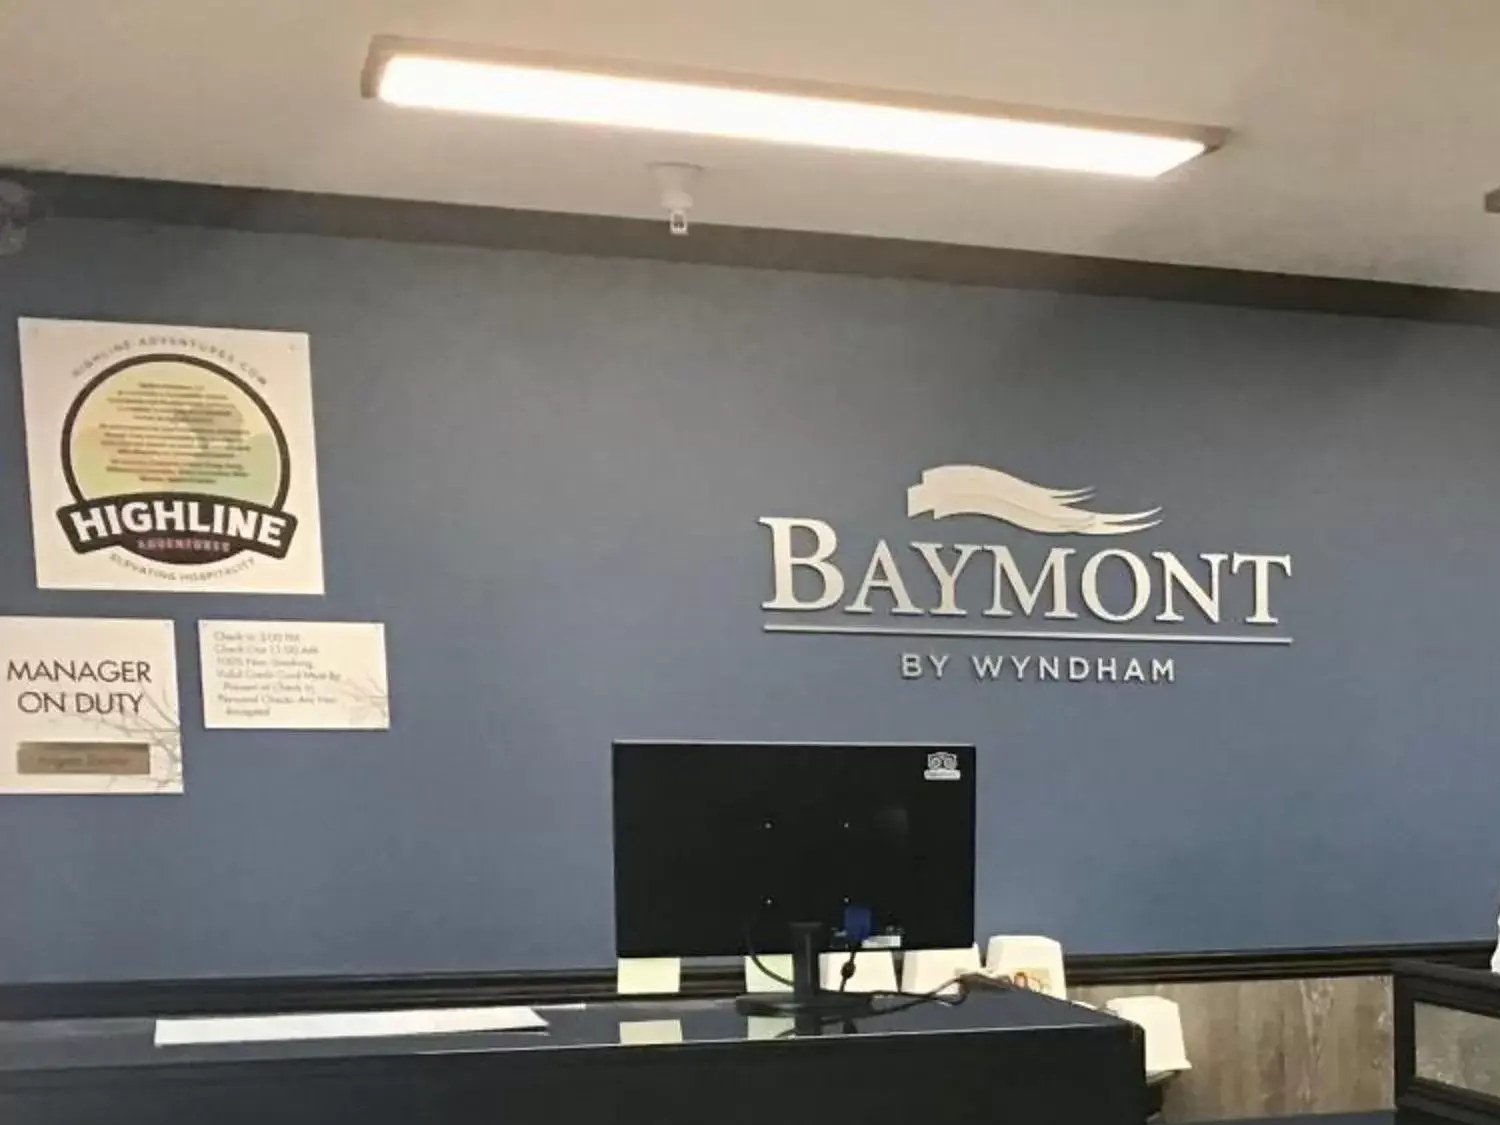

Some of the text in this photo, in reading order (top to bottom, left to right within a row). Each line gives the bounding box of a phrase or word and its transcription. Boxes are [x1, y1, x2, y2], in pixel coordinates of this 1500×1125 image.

[70, 500, 287, 547] HIGHLINE
[759, 515, 1293, 625] BAYMONT
[7, 659, 152, 683] MANAGER
[902, 653, 1175, 682] BY WYNDHAM
[17, 691, 144, 715] ON DUTY
